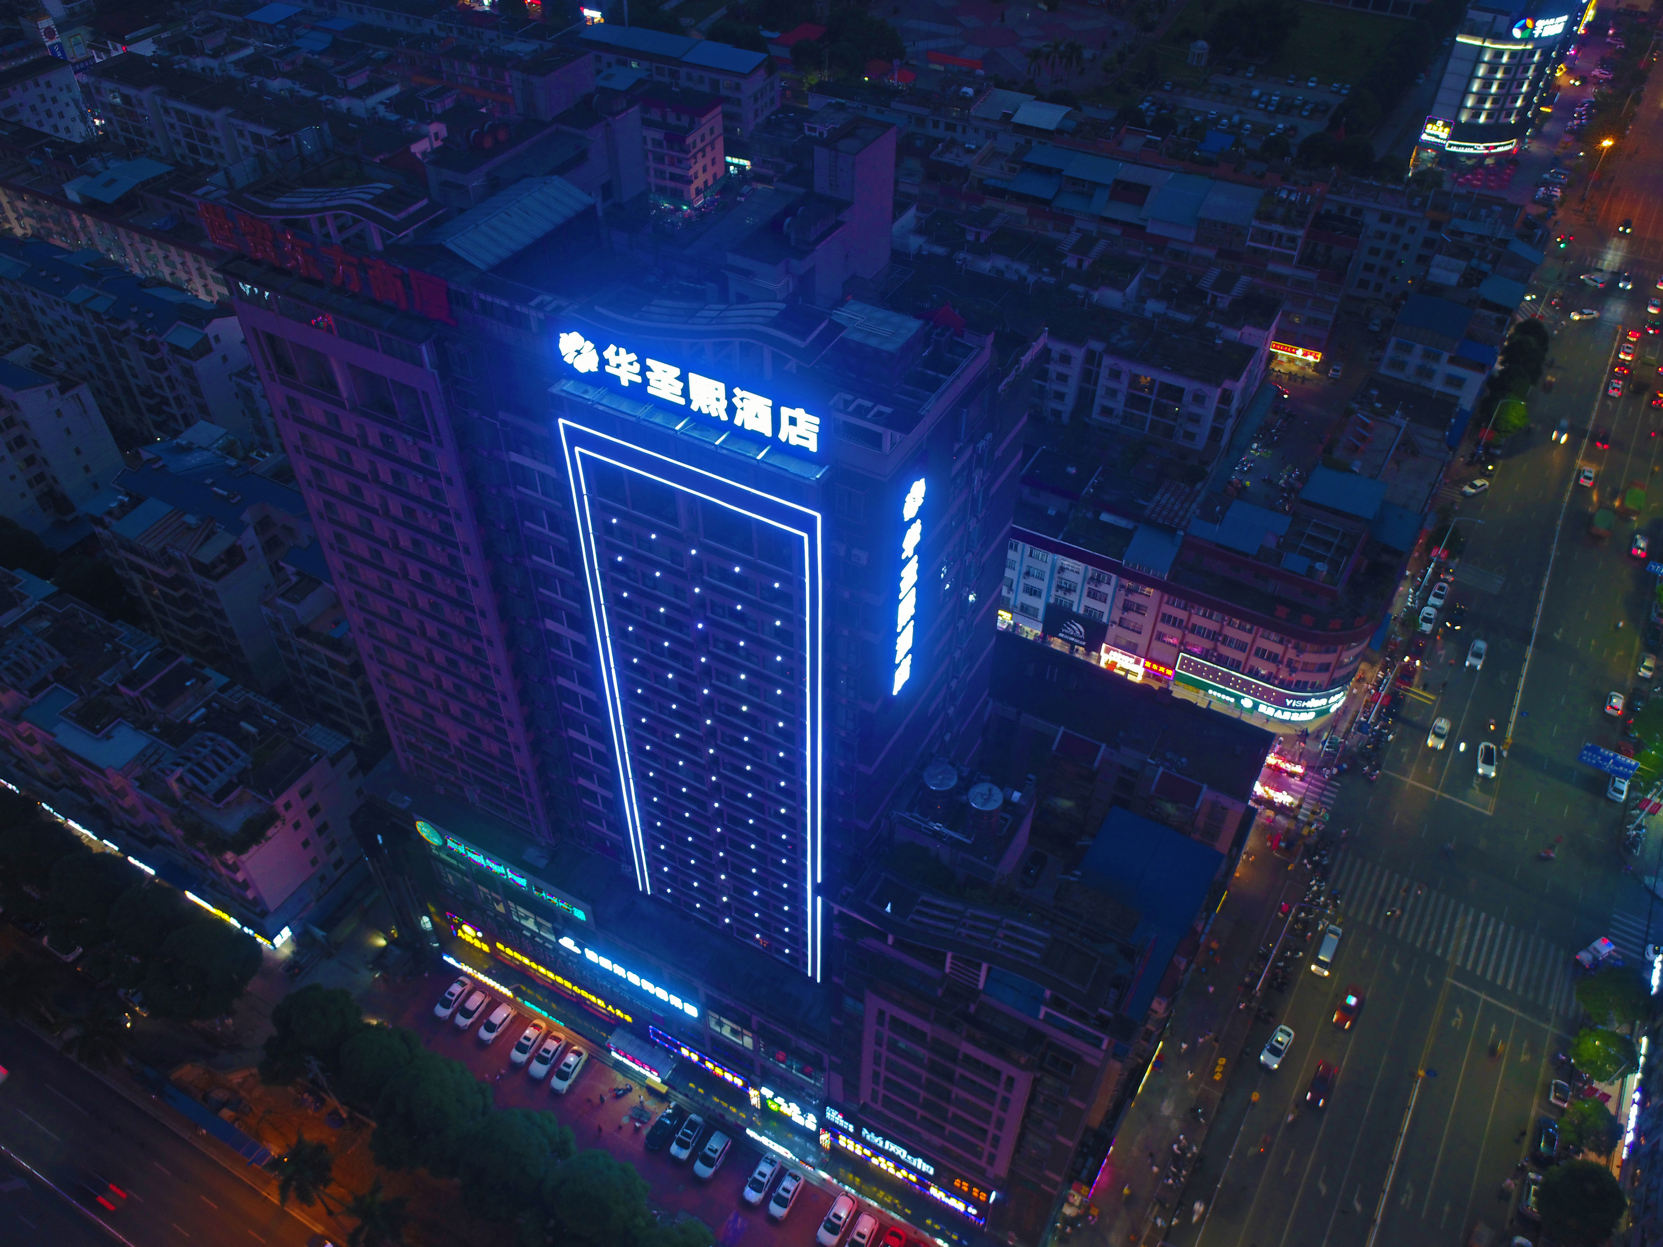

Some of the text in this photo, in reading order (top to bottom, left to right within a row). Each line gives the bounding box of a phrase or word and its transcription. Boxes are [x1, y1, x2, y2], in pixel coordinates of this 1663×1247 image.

[603, 343, 820, 453] 华圣熙酒店
